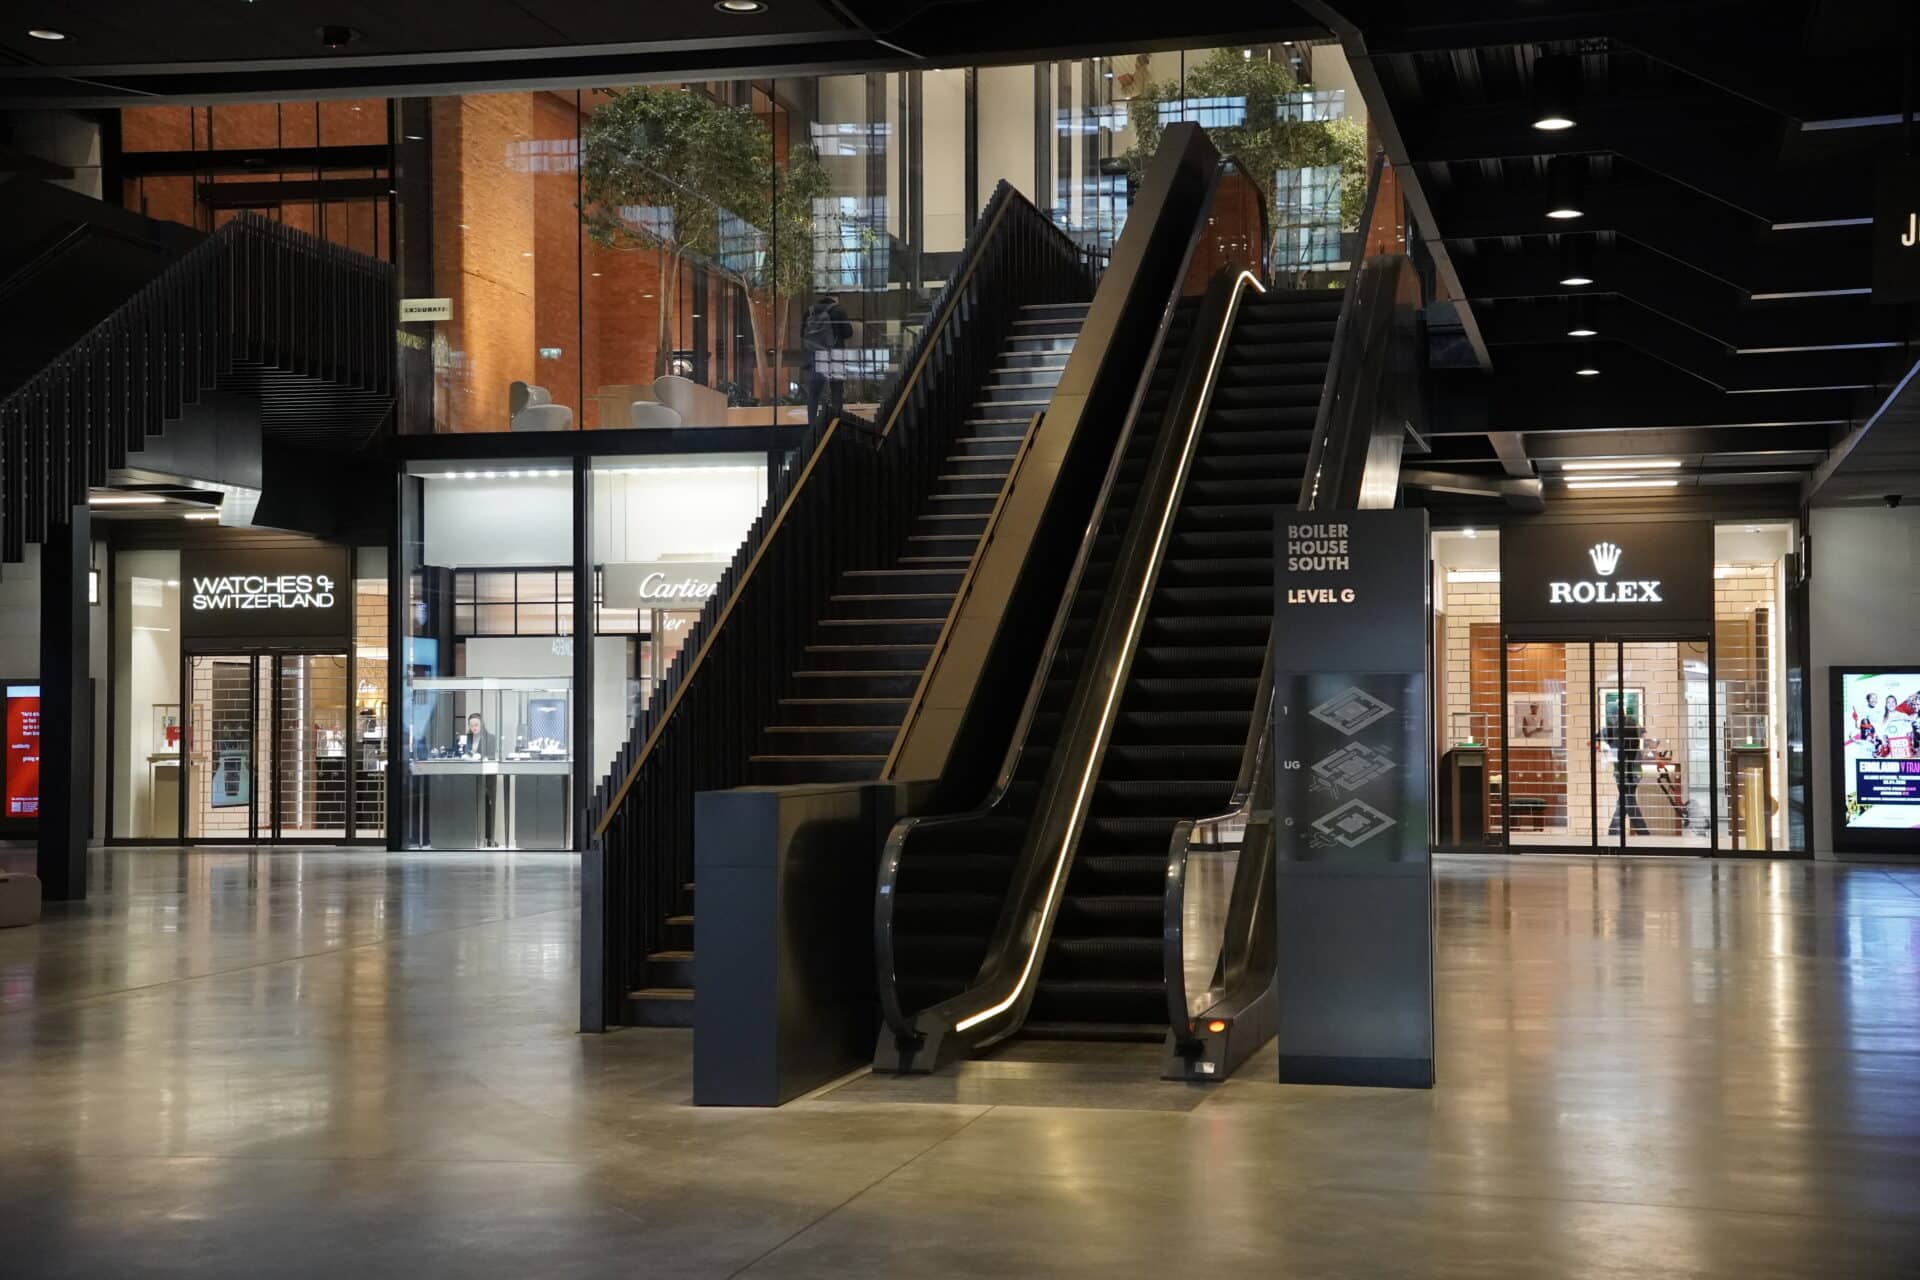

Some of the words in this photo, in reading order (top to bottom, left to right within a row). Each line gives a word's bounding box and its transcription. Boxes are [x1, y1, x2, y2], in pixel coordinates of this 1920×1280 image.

[1287, 524, 1349, 539] BOILER
[1287, 540, 1348, 555] HOUSE
[1287, 556, 1350, 571] SOUTH
[193, 575, 313, 594] WATCHES
[639, 572, 718, 598] Cartier
[1549, 581, 1663, 603] ROLEX
[193, 593, 335, 609] SWITZERLAND
[1287, 588, 1338, 603] LEVEL
[1340, 588, 1356, 603] G
[1283, 760, 1301, 770] UG
[1284, 817, 1294, 826] G
